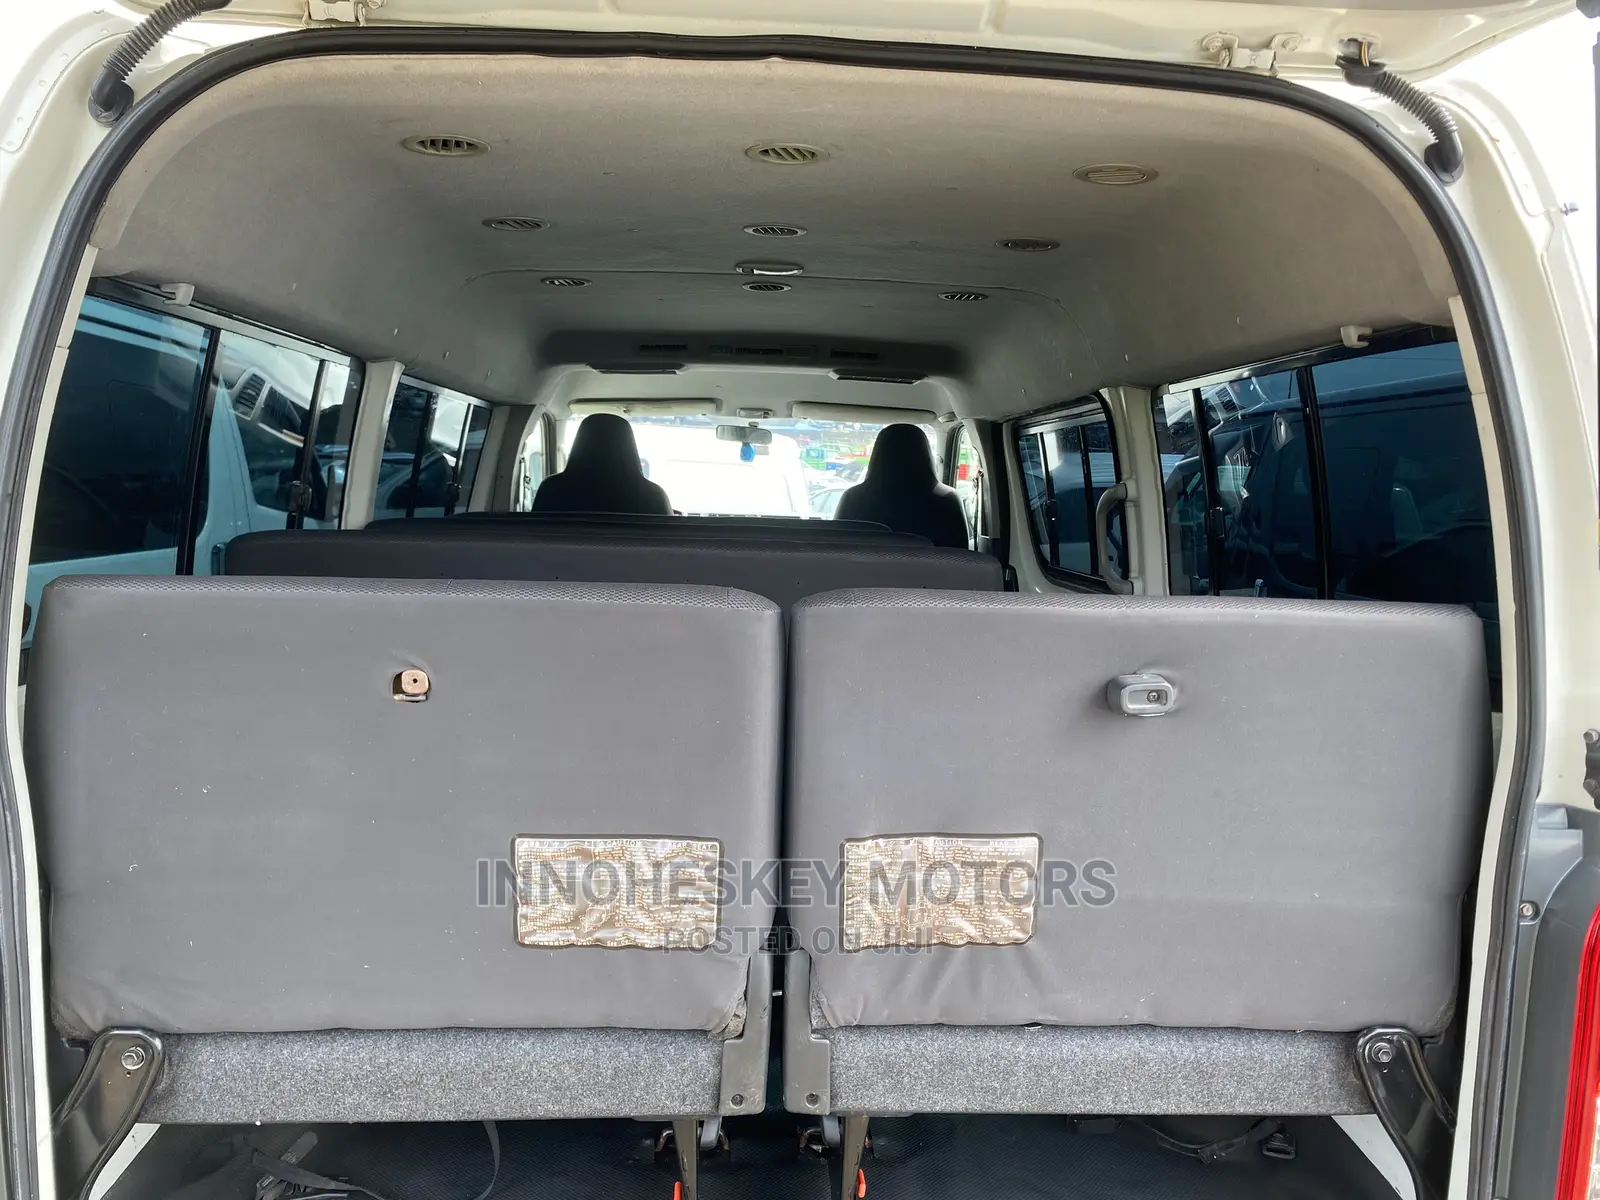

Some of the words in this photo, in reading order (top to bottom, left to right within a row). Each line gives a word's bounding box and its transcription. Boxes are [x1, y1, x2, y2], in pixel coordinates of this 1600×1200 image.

[607, 839, 641, 848] CAUTION
[692, 843, 713, 851] SEAT
[929, 839, 963, 847] AUTION
